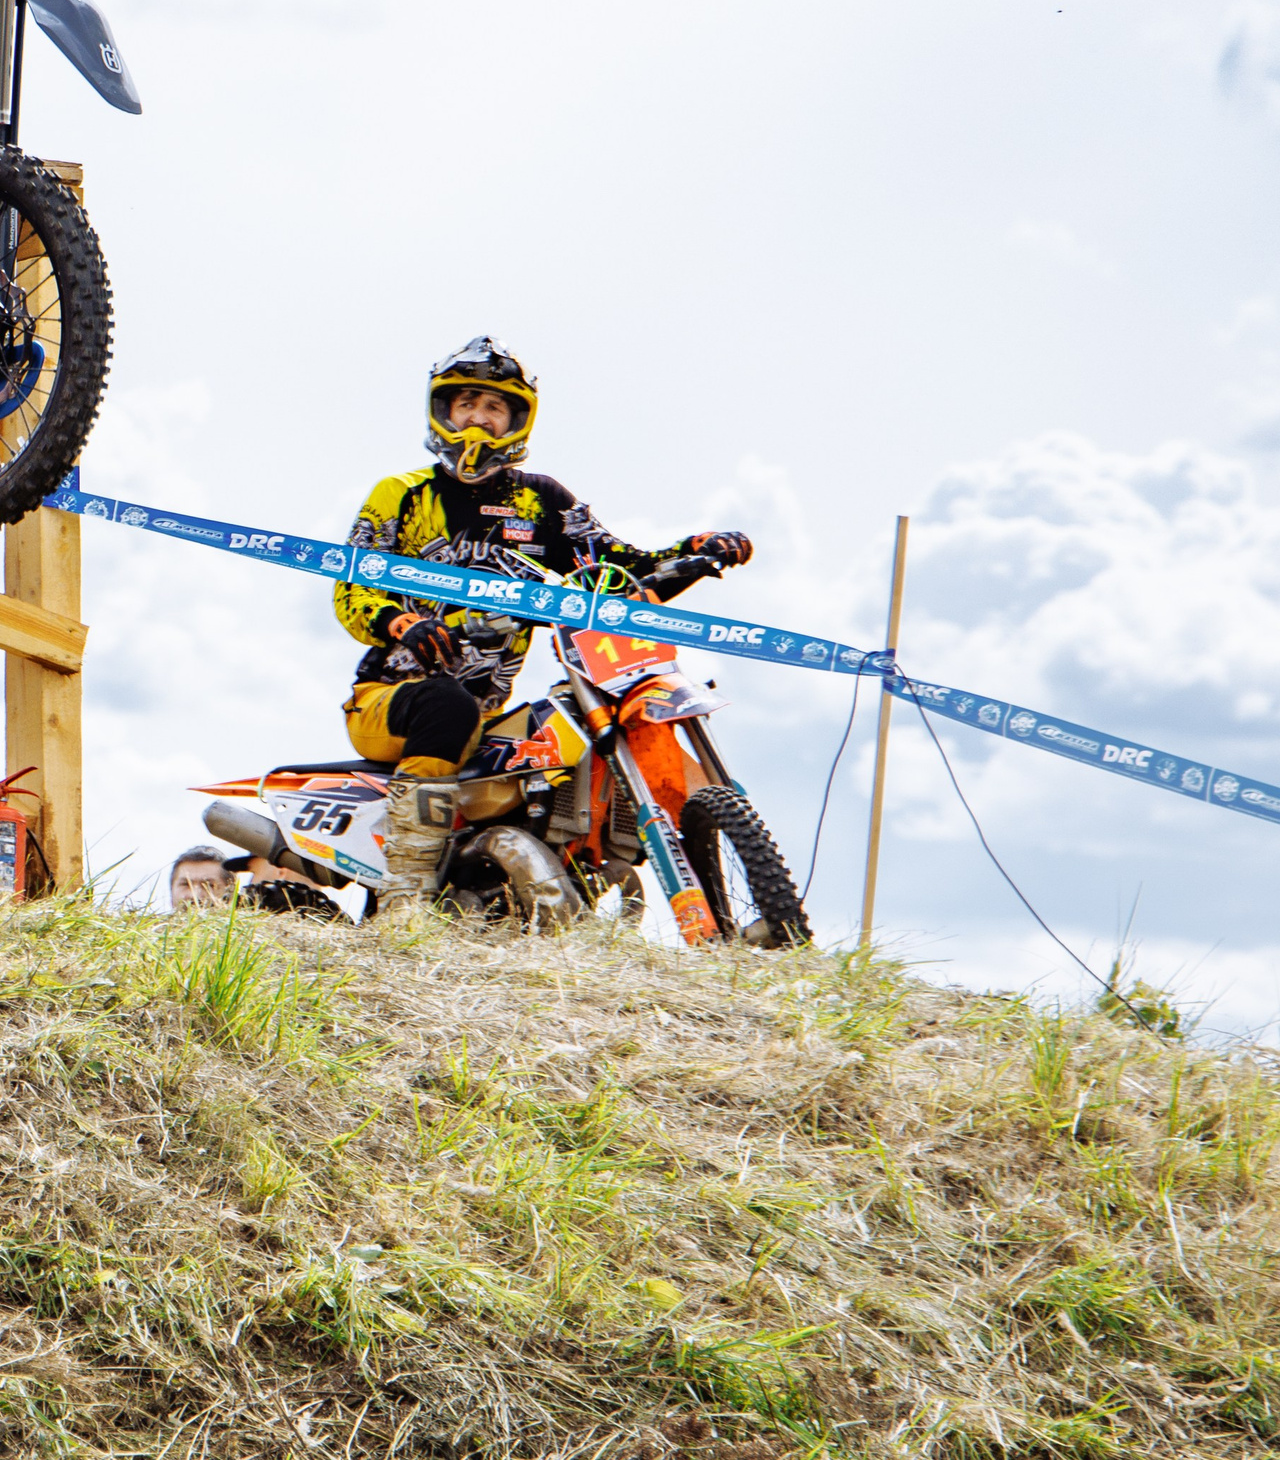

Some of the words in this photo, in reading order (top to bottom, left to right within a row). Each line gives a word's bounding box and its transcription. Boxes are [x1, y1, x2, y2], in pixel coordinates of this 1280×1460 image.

[481, 507, 515, 516] KENDA
[505, 520, 532, 530] LIQUI
[229, 533, 285, 551] DRC
[505, 530, 533, 540] MOLY
[467, 578, 526, 598] DRC
[493, 596, 521, 605] TEAM
[653, 617, 701, 630] MAXIMA
[708, 624, 766, 644] DRC
[1102, 744, 1154, 768] DRC
[291, 799, 358, 836] 55
[651, 804, 695, 888] METZELER
